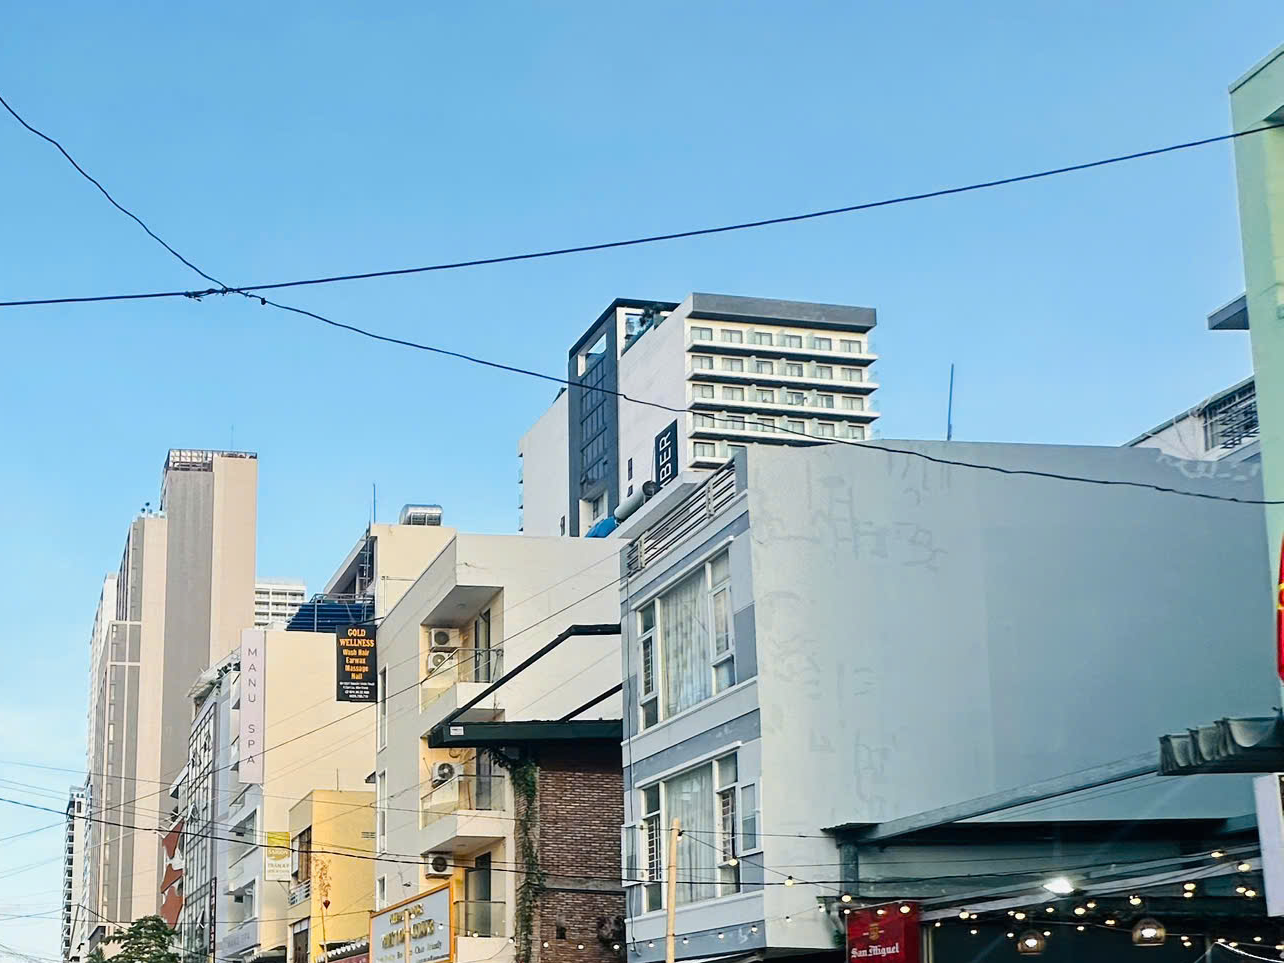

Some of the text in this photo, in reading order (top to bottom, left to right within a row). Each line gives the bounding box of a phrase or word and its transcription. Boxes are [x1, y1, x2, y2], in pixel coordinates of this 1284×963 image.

[659, 431, 672, 487] BER
[347, 628, 367, 637] GOLD
[339, 638, 375, 648] WELLNESS
[246, 647, 258, 764] MANU SPA
[851, 942, 900, 958] San Miguel
